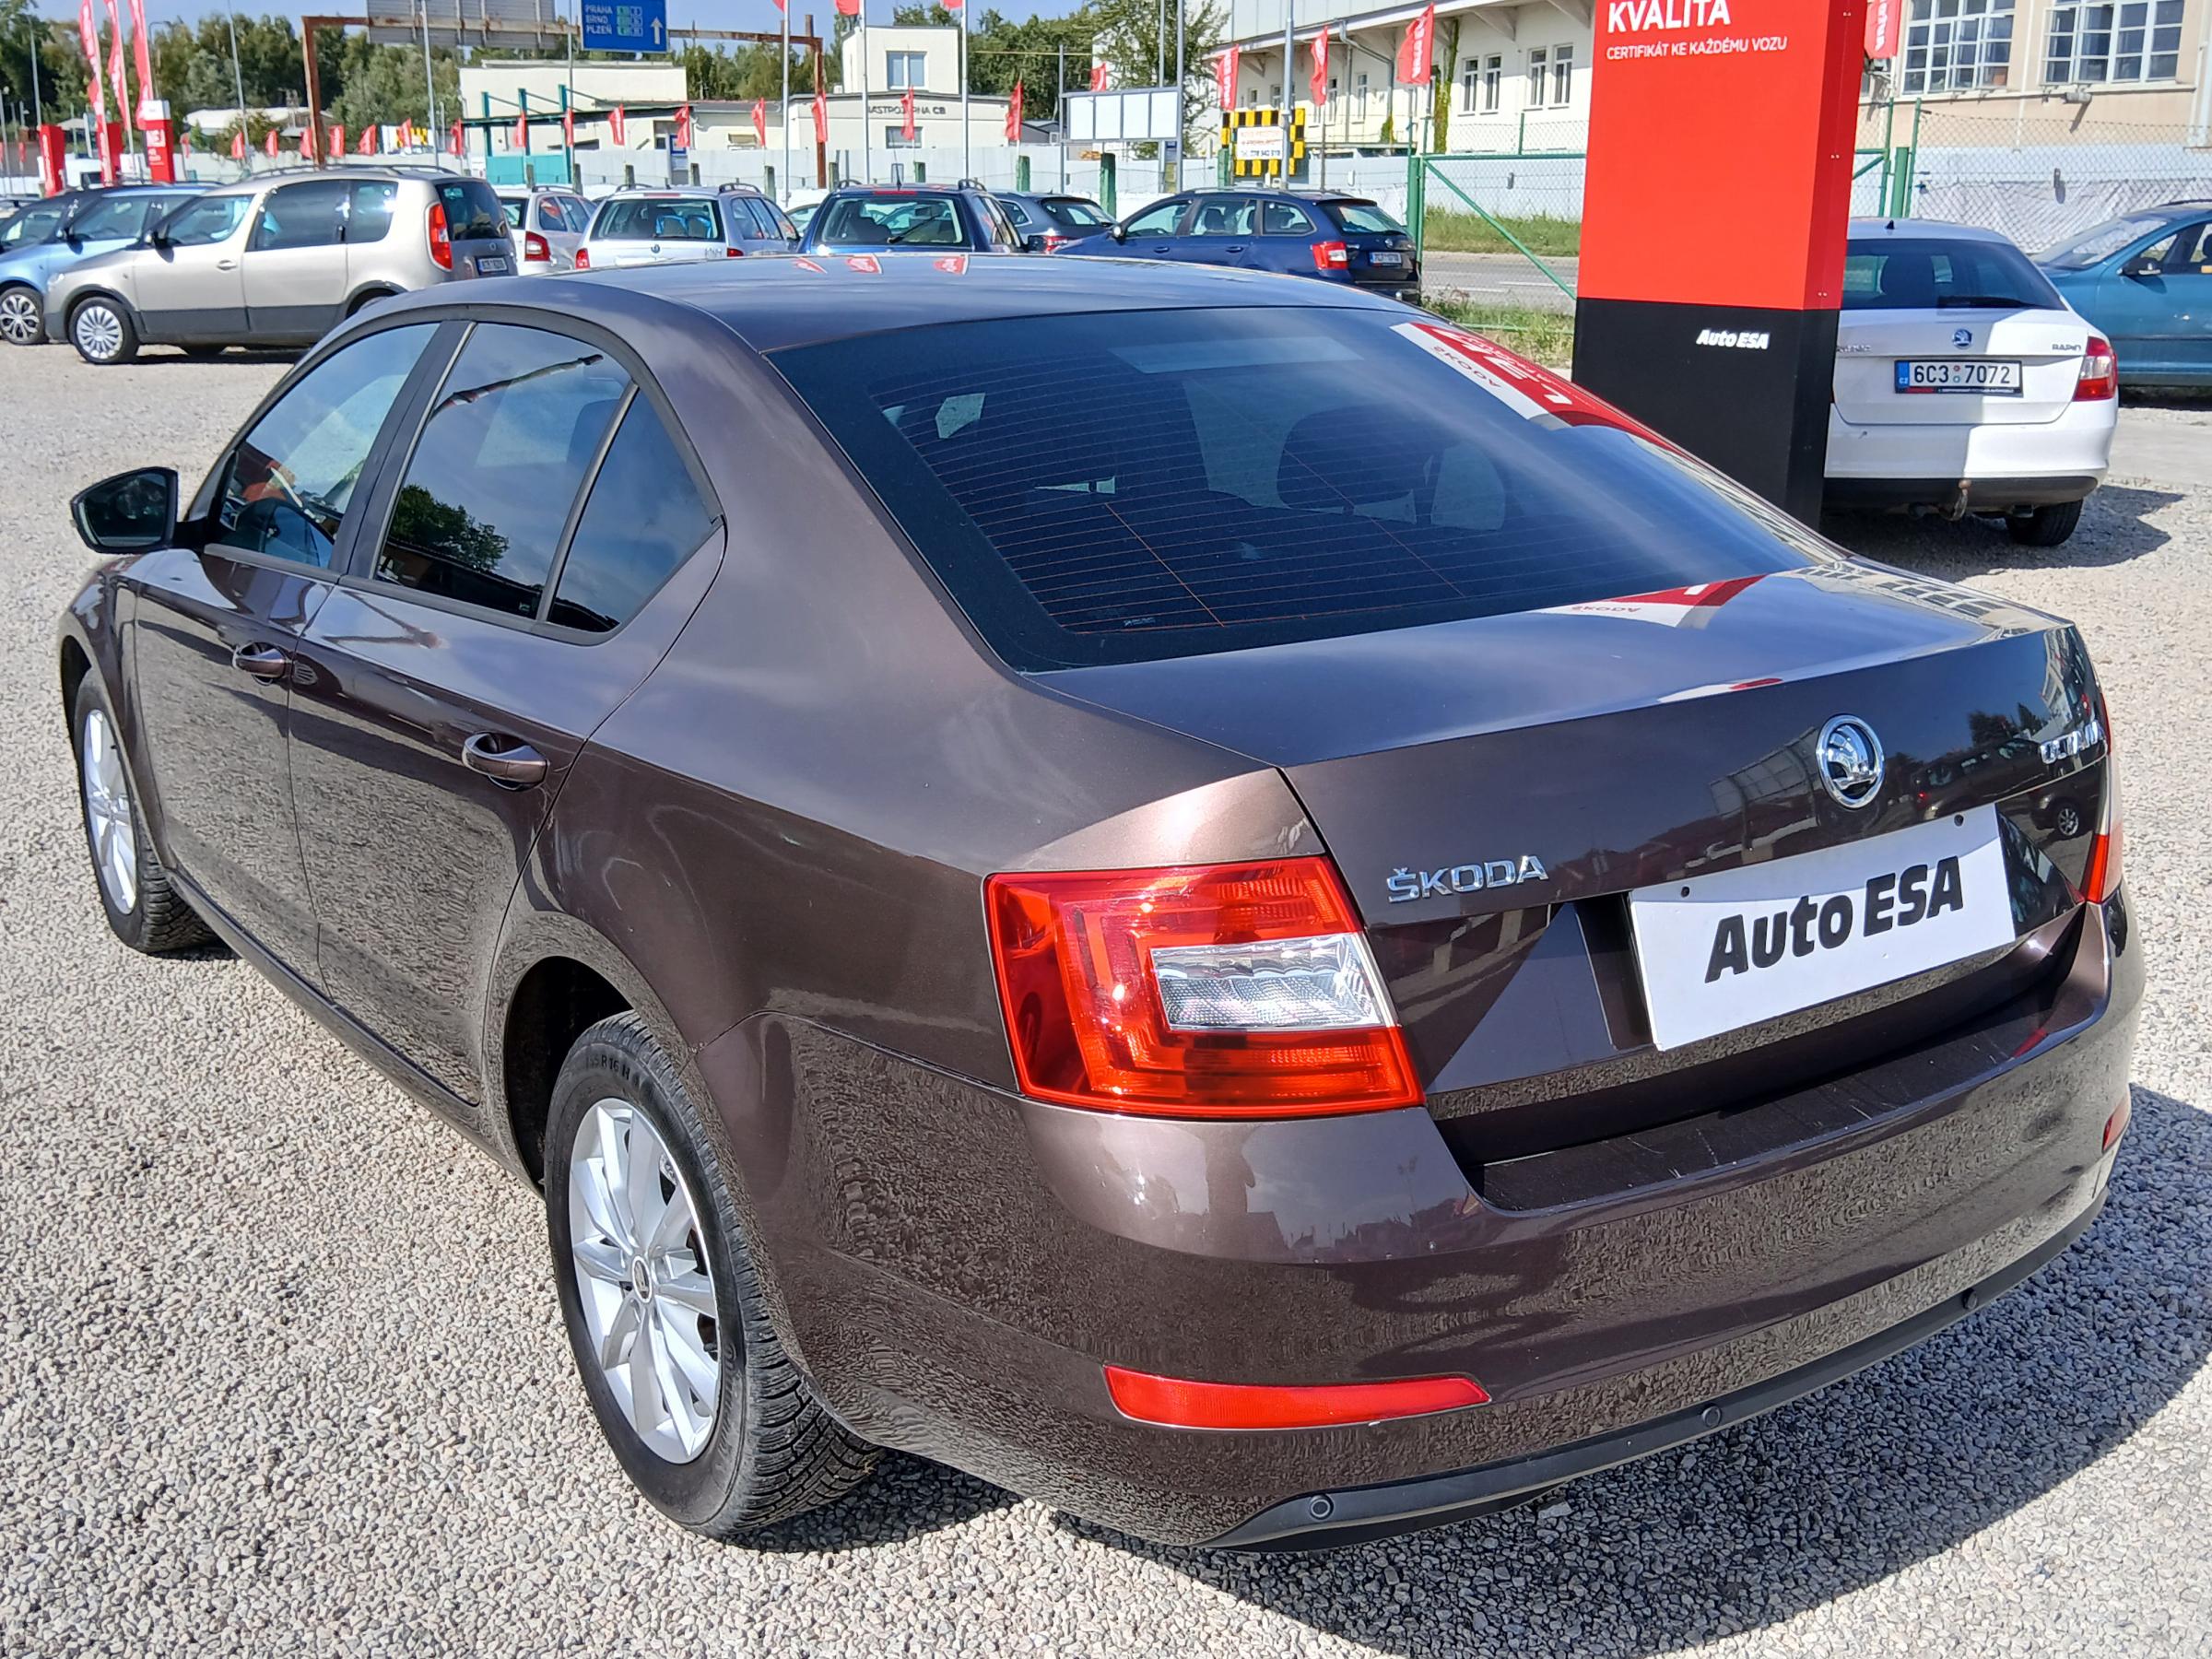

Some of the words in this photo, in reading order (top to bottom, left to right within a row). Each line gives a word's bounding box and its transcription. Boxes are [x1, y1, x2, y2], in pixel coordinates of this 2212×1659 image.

[1607, 0, 1731, 33] KVALITA
[1606, 41, 1669, 60] CERTIFIKÁT
[1671, 41, 1687, 56] KE
[1688, 37, 1749, 55] KAŽDÉMU
[1751, 35, 1788, 52] VOZU
[1696, 329, 1737, 347] Auto
[1736, 332, 1770, 349] ESA
[1914, 365, 1949, 383] 6C3
[1964, 365, 2011, 384] 7072
[1386, 854, 1549, 903] ŠKODA
[1704, 894, 1853, 984] Auto
[1864, 856, 1964, 938] ESA
